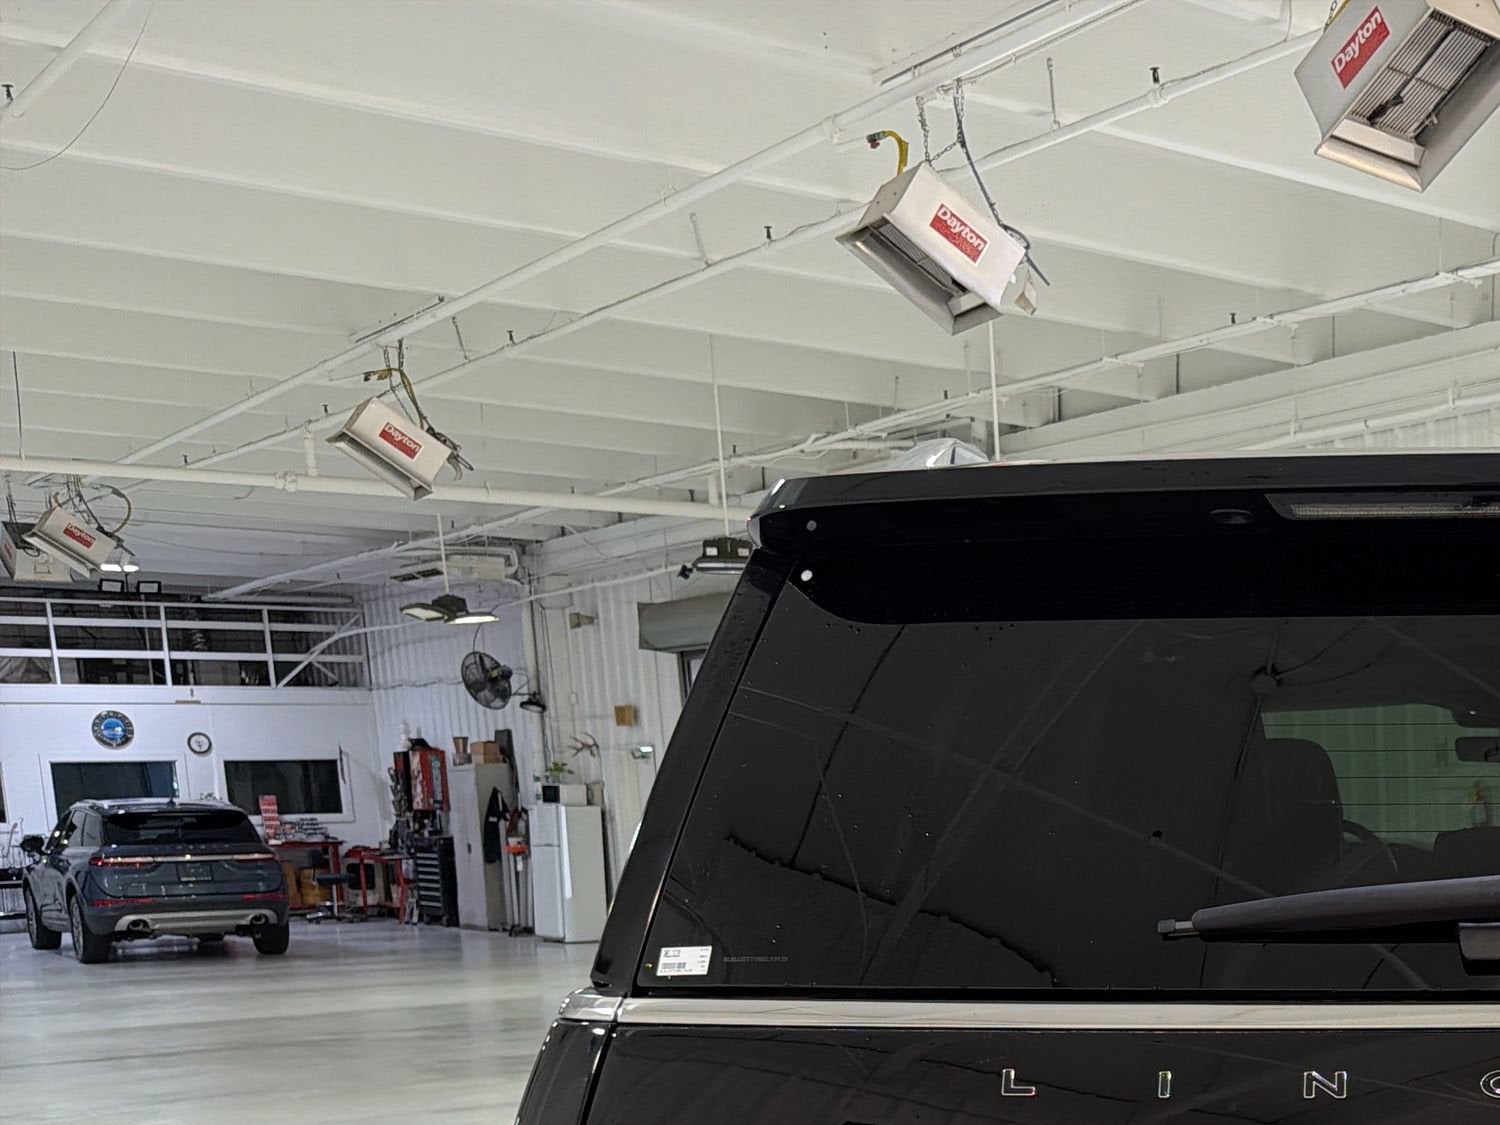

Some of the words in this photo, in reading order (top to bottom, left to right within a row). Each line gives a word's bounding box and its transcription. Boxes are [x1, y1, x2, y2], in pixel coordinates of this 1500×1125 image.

[1333, 11, 1382, 74] Dayton
[937, 205, 985, 251] Dayton
[384, 424, 420, 452] Dayton
